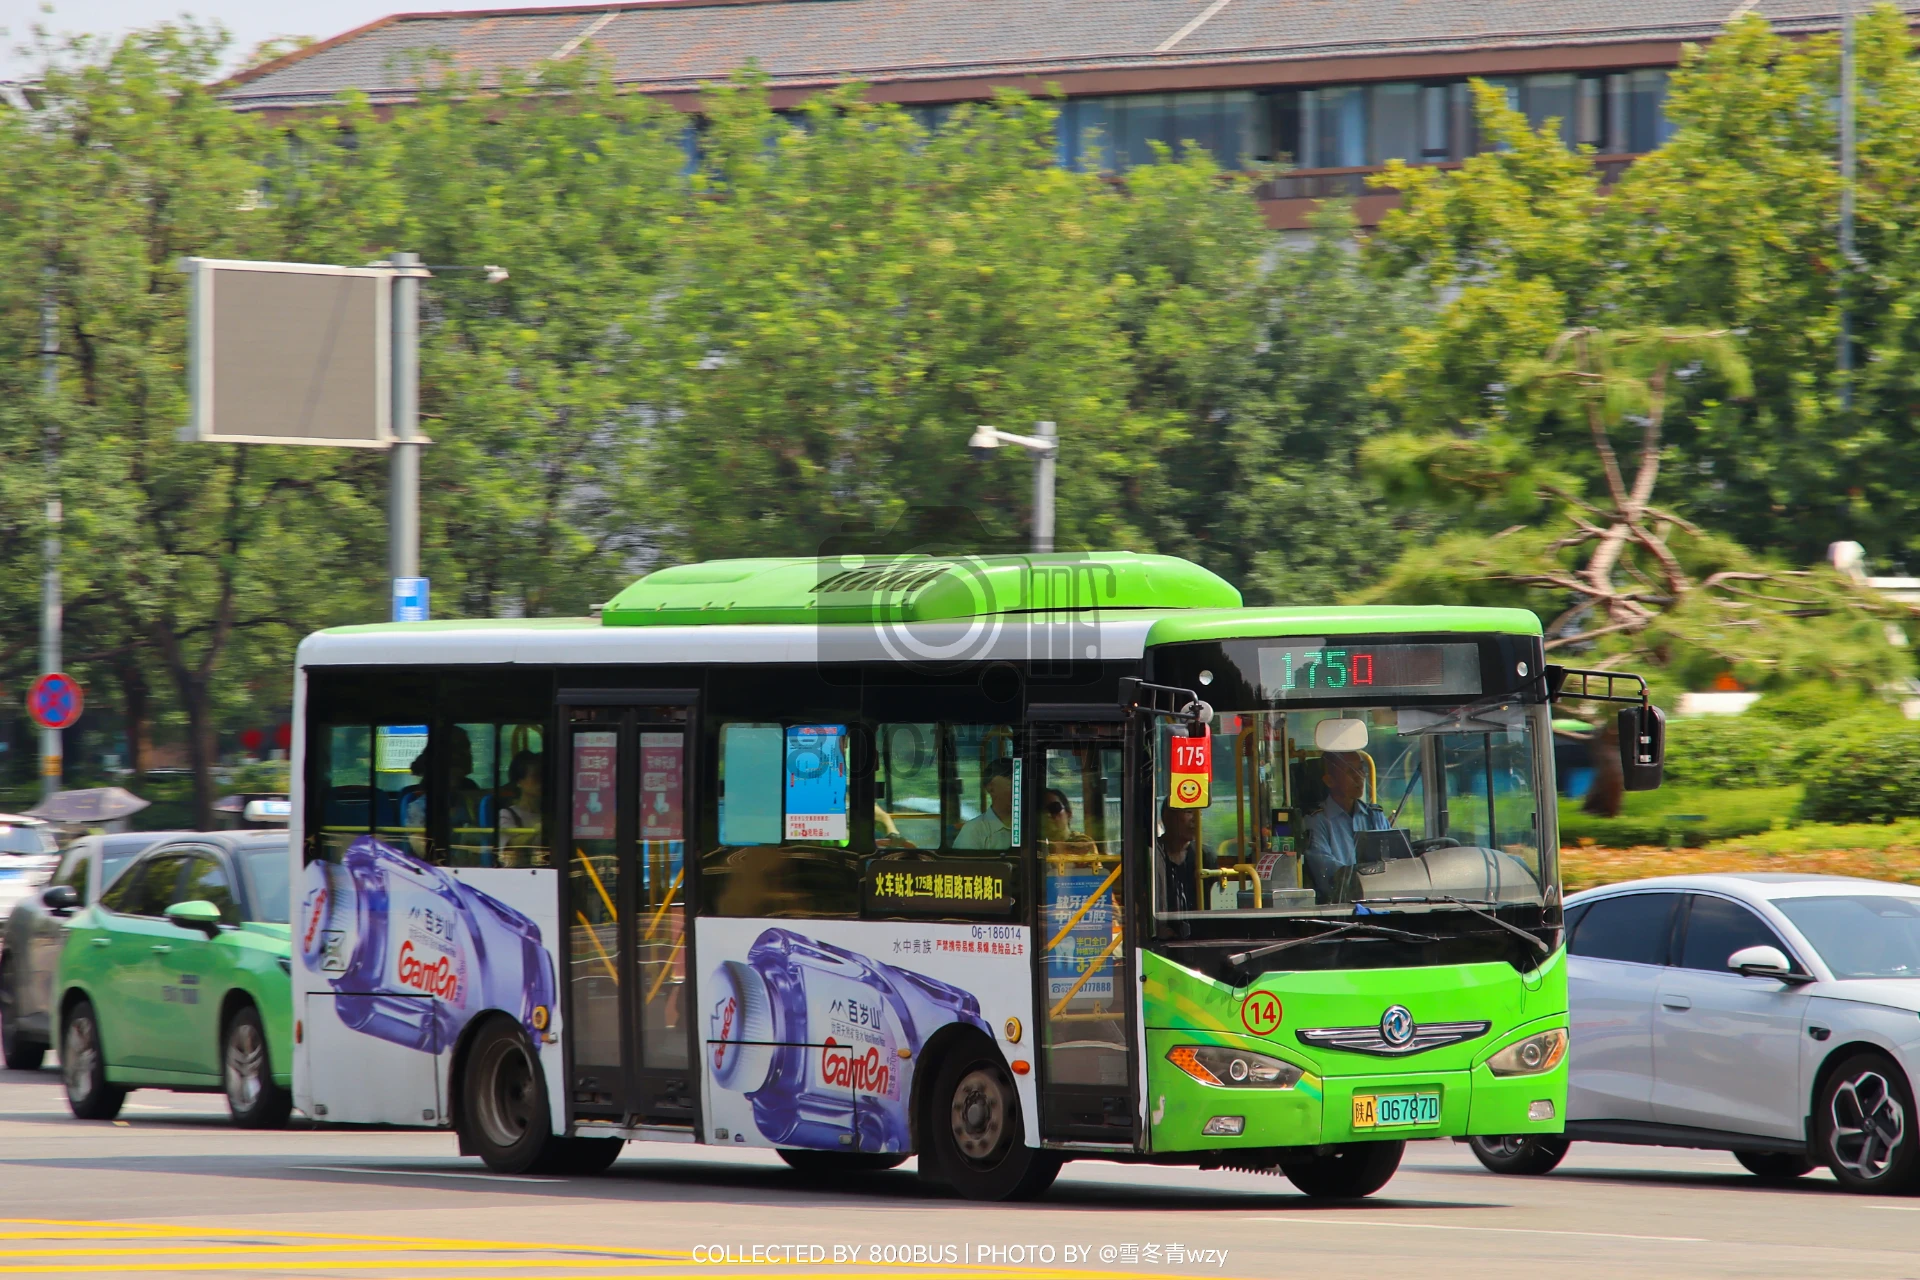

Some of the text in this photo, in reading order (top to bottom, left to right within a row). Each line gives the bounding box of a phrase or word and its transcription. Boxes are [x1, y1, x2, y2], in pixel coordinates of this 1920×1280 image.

[1281, 651, 1347, 690] 175
[1176, 746, 1205, 766] 175
[875, 872, 1003, 900] 火车站北 175路 桃园路西斜路口
[1054, 910, 1107, 925] 中口腔
[971, 925, 1021, 939] 06-186014
[892, 938, 932, 954] 水中贵族
[399, 939, 458, 1002] Ganten
[847, 998, 881, 1031] 百岁山
[1250, 1001, 1276, 1025] 14
[822, 1036, 889, 1095] Ganten
[1355, 1097, 1438, 1122] 陕A 06787D
